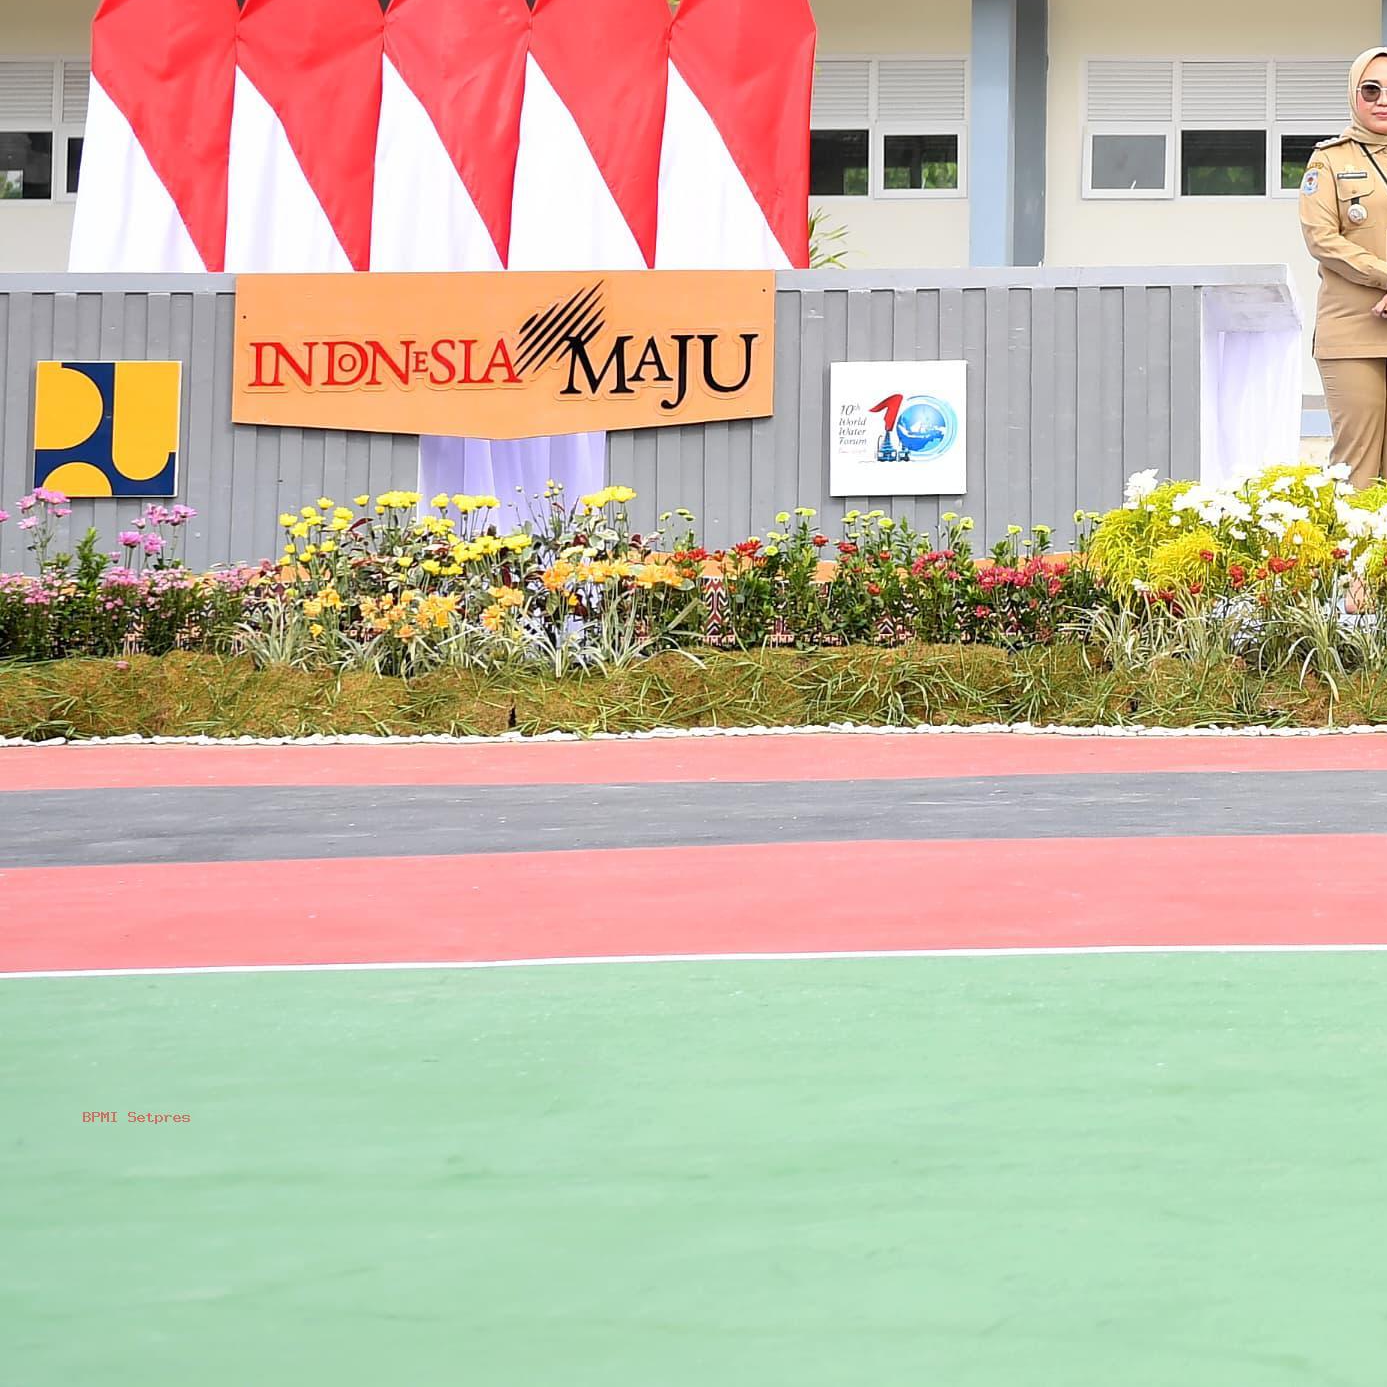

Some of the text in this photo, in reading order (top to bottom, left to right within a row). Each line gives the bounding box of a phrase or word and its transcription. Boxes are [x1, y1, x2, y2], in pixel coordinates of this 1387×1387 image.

[247, 333, 759, 410] INDONESIA MAJU
[839, 416, 867, 426] World
[839, 427, 867, 436] Water
